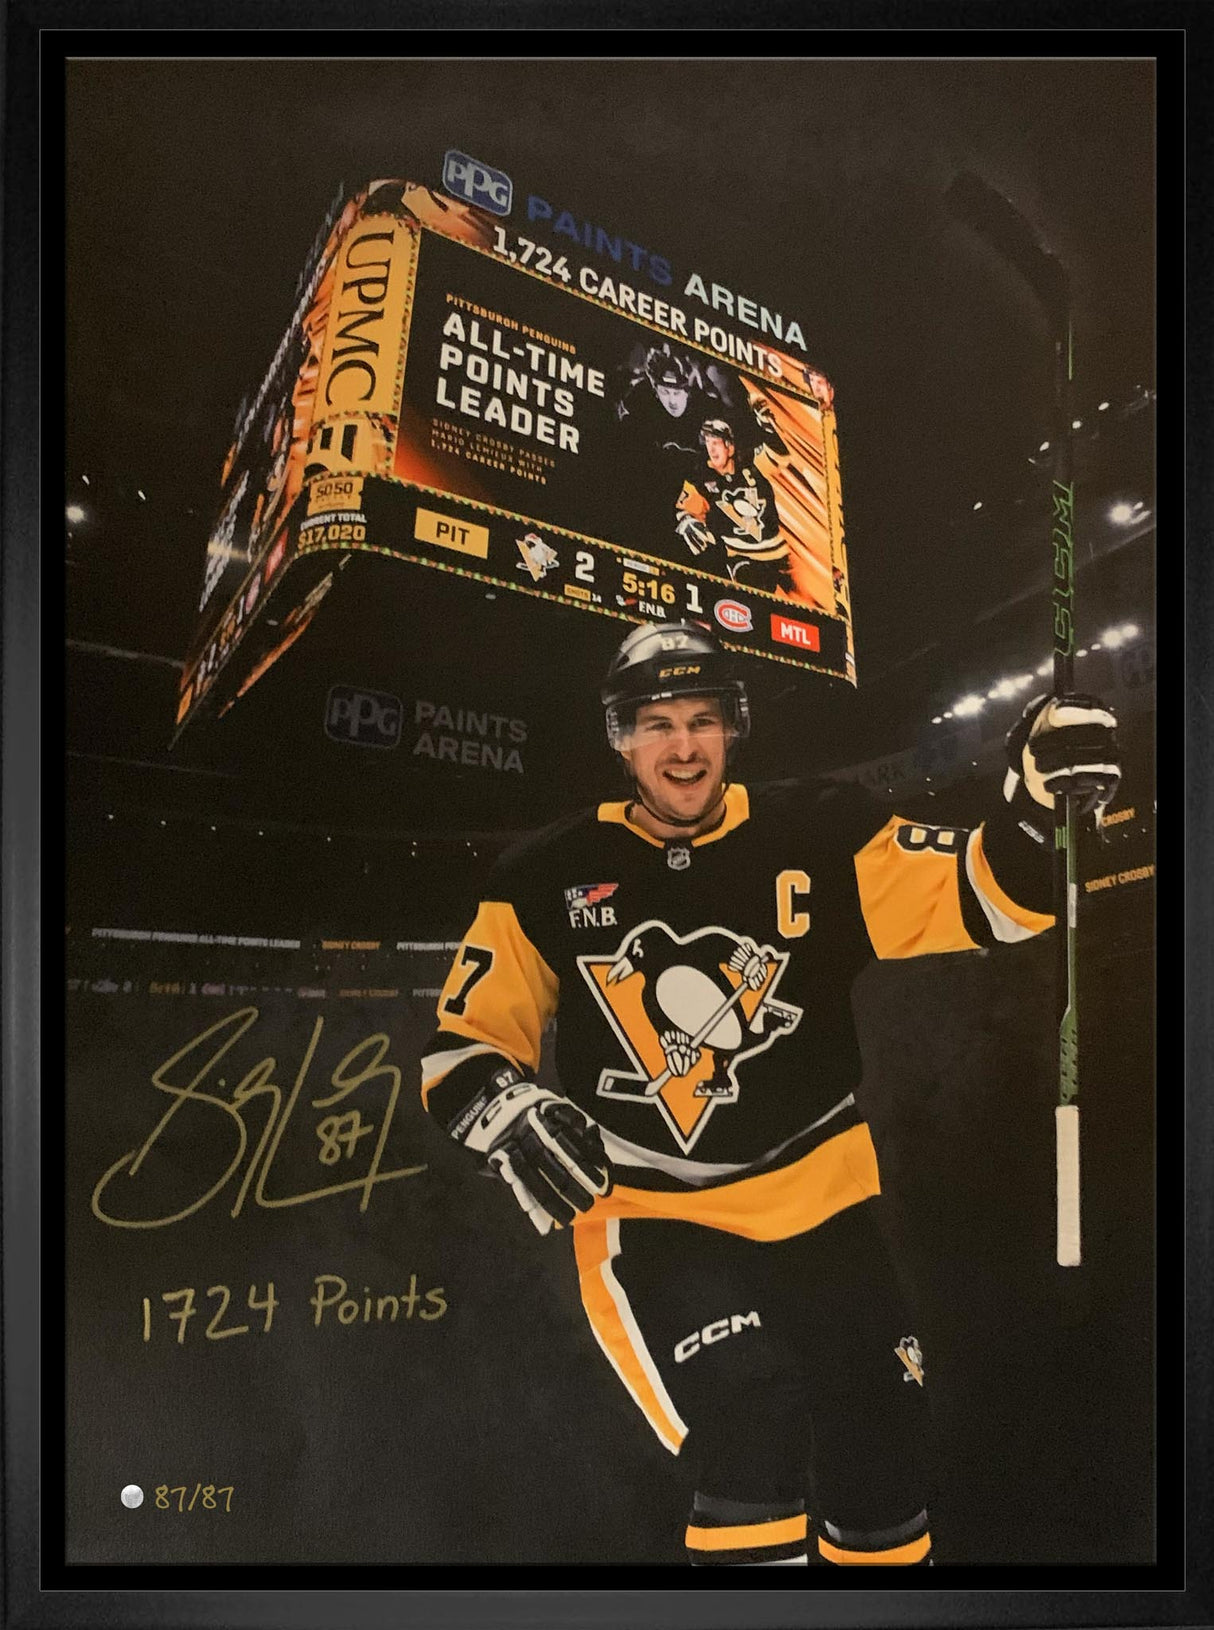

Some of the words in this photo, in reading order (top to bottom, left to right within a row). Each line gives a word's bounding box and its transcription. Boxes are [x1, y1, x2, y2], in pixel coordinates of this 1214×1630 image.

[446, 157, 509, 208] PPG
[526, 194, 673, 286] PAINTS
[684, 273, 808, 351] ARENA
[325, 229, 395, 407] UPMC
[445, 292, 519, 331] PITTSBURGH
[521, 324, 577, 355] PENGUINS
[493, 225, 572, 283] 1,724
[579, 267, 687, 337] CAREER
[694, 317, 783, 378] POINTS
[439, 342, 574, 418] POINTS
[442, 311, 605, 399] ALL-TIME
[436, 376, 580, 455] LEADER
[436, 521, 470, 545] PIT
[574, 551, 596, 584] 2
[622, 571, 676, 605] 5:16
[685, 582, 704, 614] 1
[780, 622, 812, 645] MTL
[331, 694, 399, 738] PPG
[415, 699, 528, 743] PAINTS
[412, 732, 525, 774] ARENA
[775, 869, 812, 940] C
[442, 944, 494, 1017] 7
[316, 1110, 375, 1166] 87
[142, 1280, 280, 1344] 1724
[310, 1273, 448, 1328] Points
[673, 1310, 762, 1364] CCM
[154, 1482, 235, 1512] 87/87
